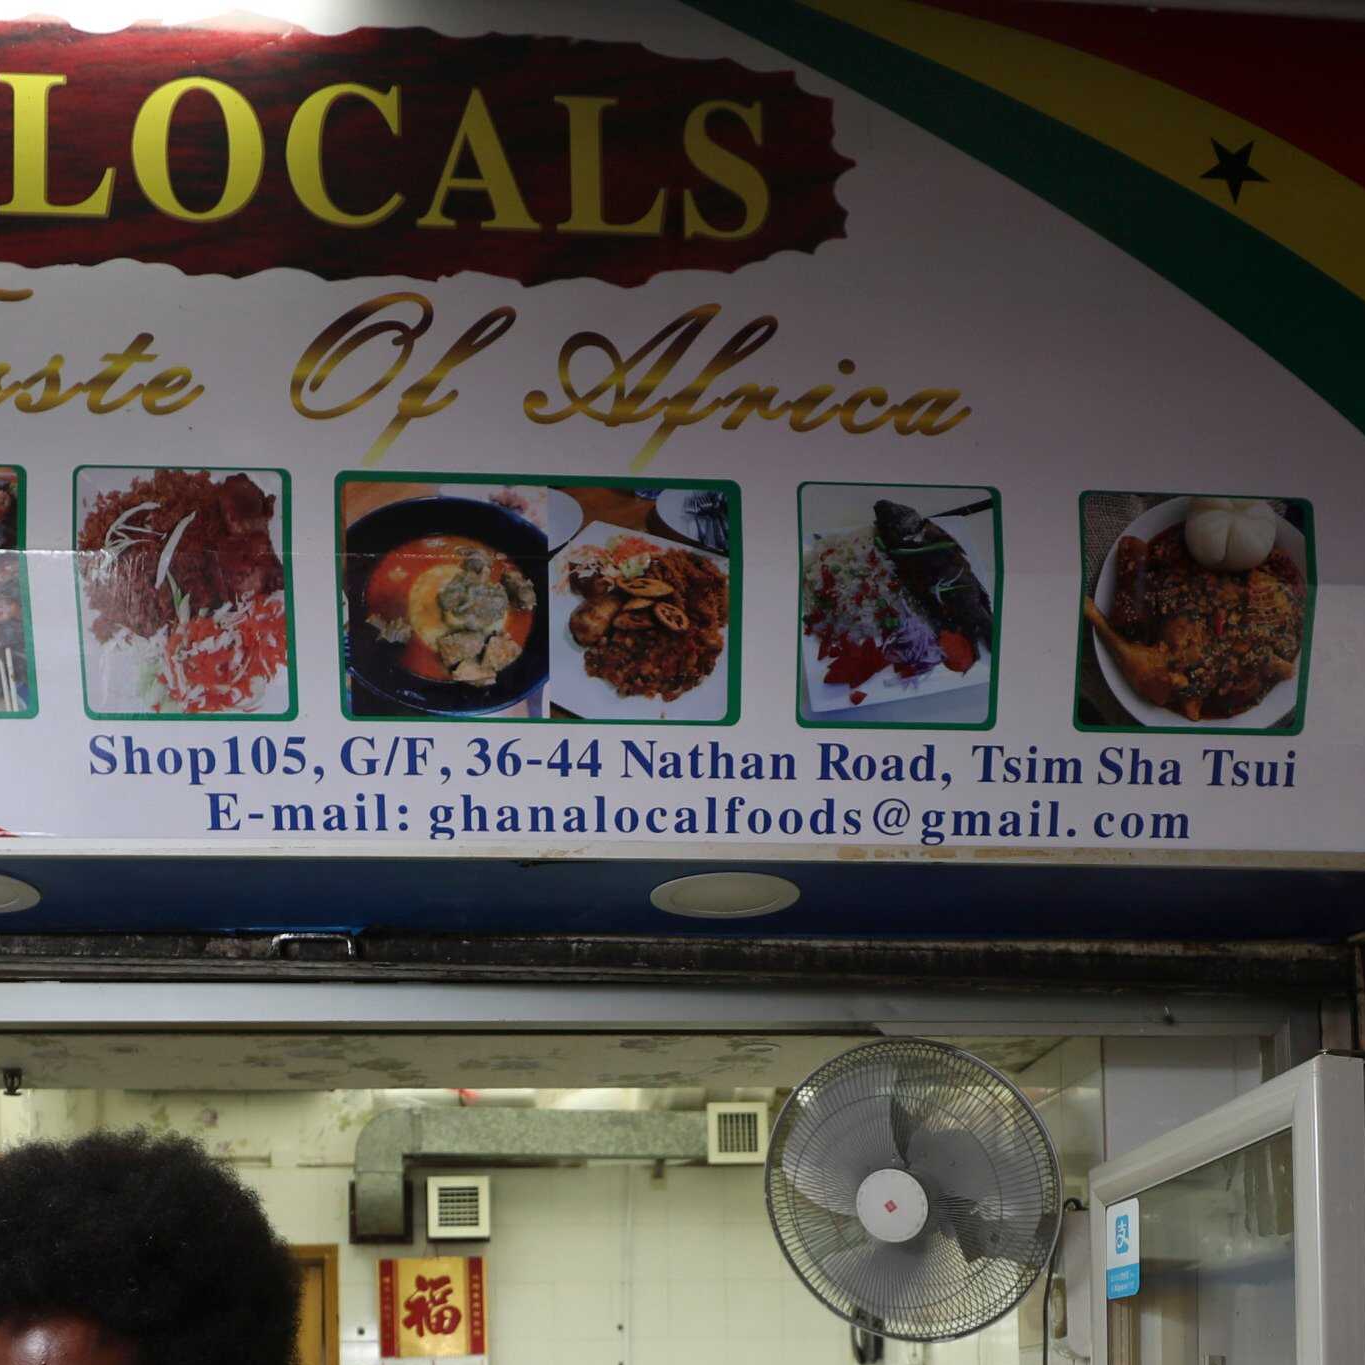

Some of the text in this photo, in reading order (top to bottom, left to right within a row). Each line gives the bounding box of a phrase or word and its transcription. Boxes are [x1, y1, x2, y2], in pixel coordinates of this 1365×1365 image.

[290, 291, 515, 467] Of
[524, 303, 972, 473] Africa
[89, 735, 1296, 788] Shop105, G/F, 36-44 Nathan Road, Tsim Sha Tsui
[206, 792, 409, 833] E-mail:
[401, 1274, 462, 1338] 福
